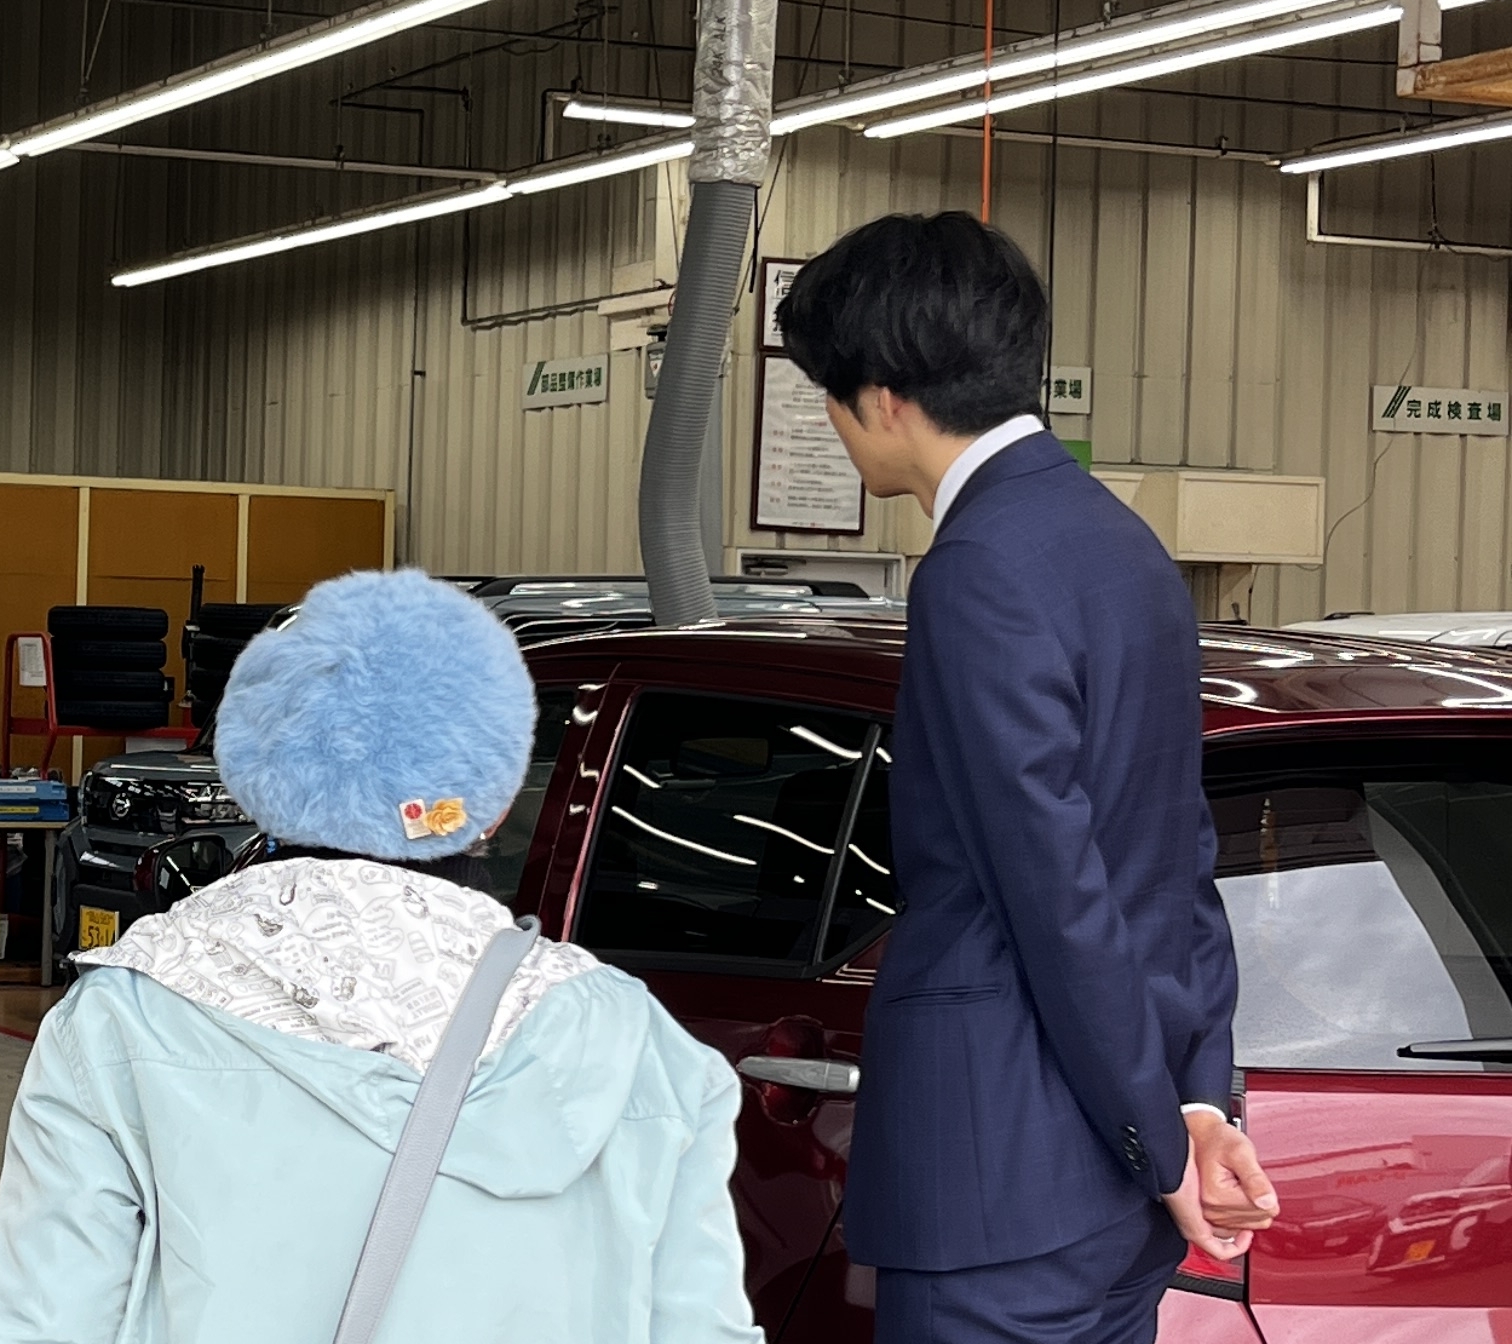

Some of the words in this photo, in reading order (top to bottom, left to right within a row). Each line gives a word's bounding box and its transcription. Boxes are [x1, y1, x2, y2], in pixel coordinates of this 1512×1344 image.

[1043, 378, 1082, 399] 業場
[1406, 399, 1502, 422] 完成検査場
